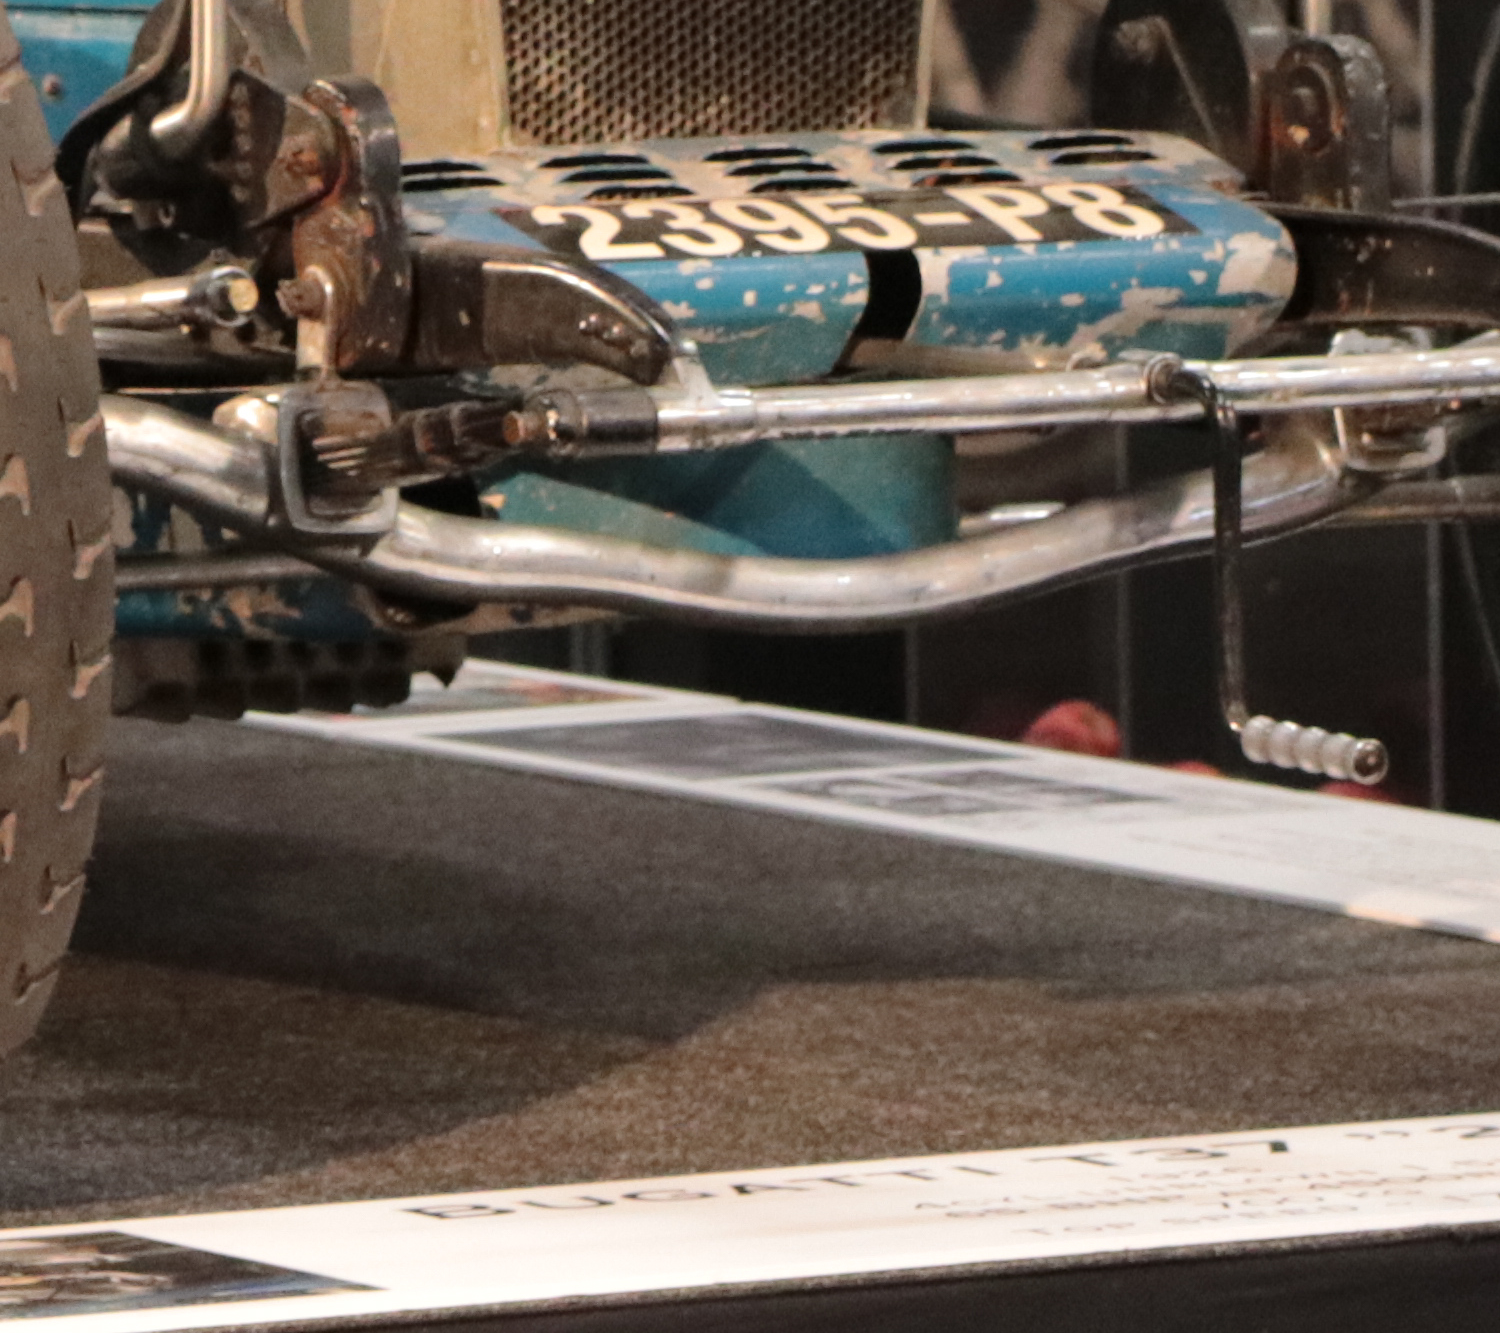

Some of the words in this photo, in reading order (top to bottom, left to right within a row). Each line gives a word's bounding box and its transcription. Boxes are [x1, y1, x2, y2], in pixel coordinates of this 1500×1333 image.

[530, 182, 1165, 262] 2395-P8
[400, 1164, 1002, 1221] BUGATTI
[1027, 1140, 1290, 1167] T37
